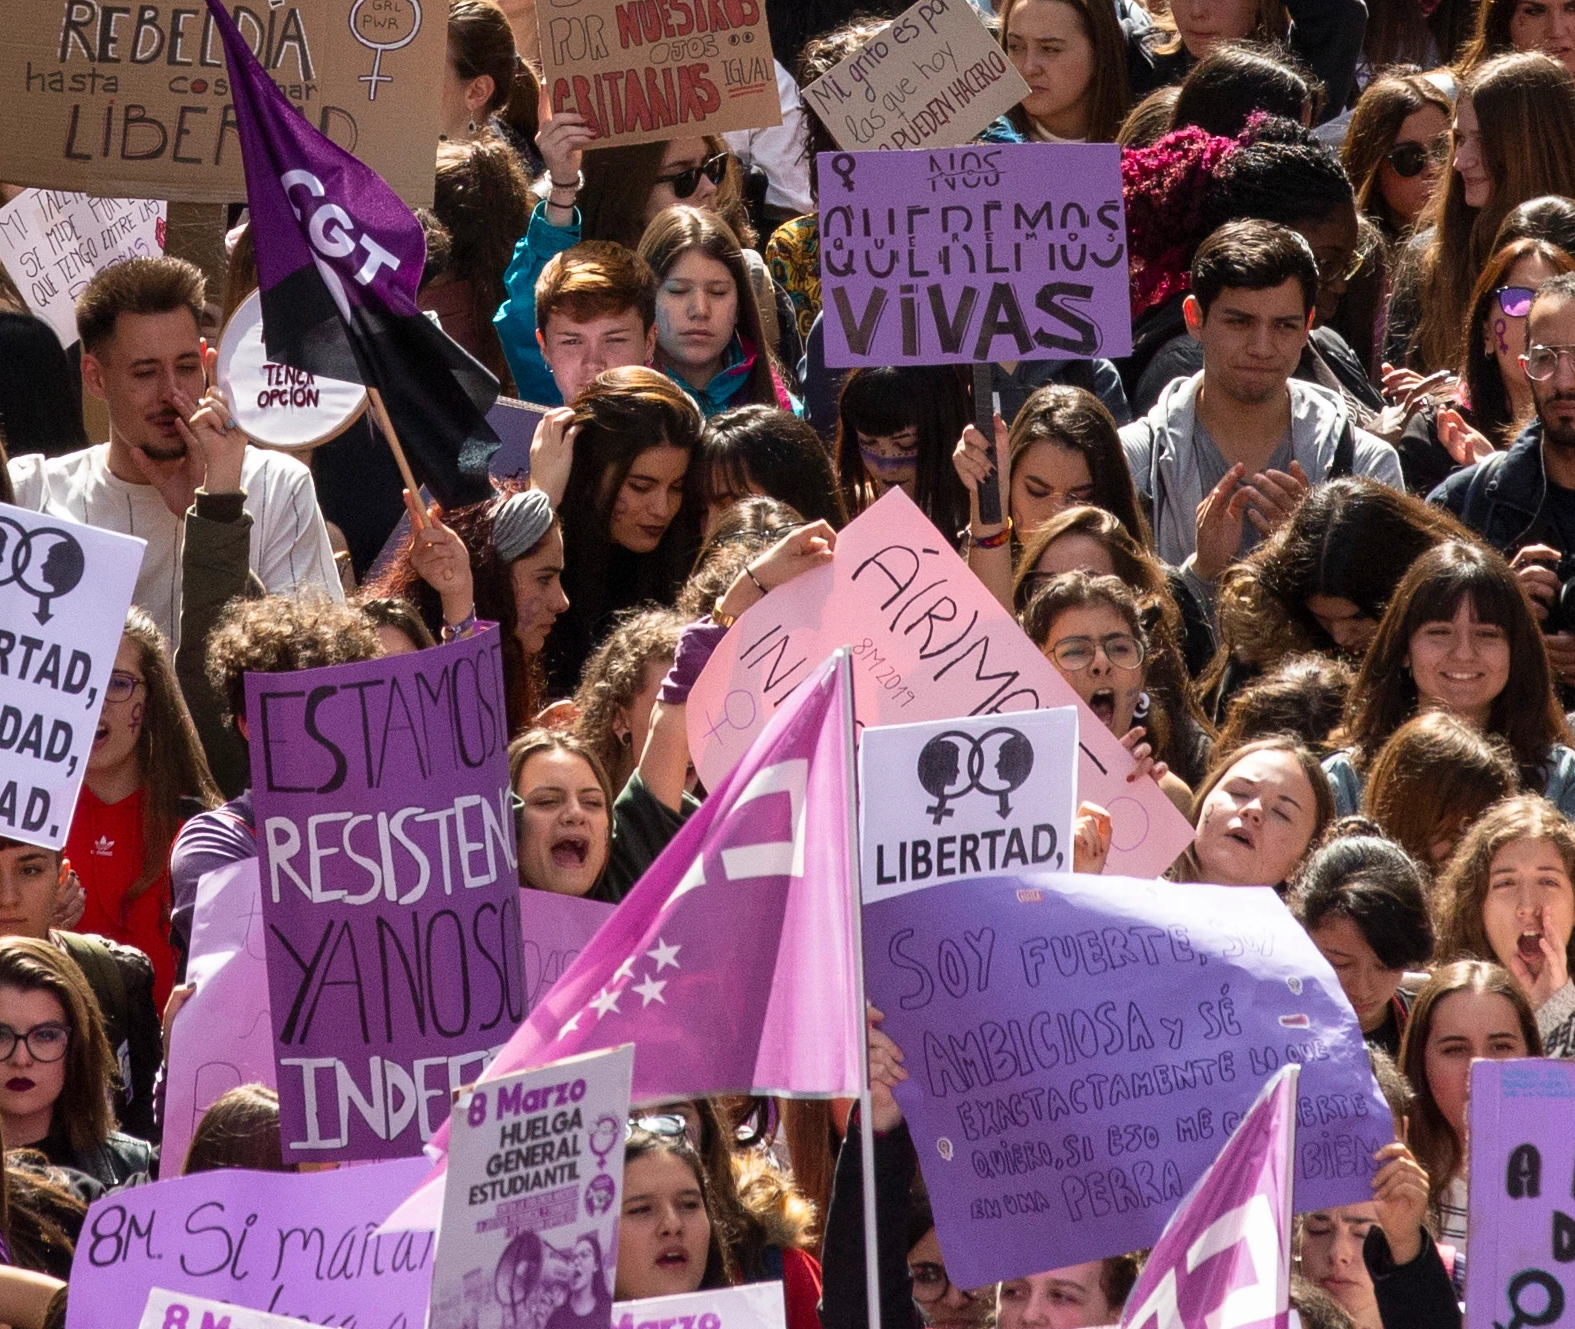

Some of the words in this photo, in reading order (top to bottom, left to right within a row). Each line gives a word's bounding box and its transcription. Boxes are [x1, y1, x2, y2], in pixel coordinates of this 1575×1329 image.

[362, 14, 400, 30] PWR
[371, 0, 402, 13] GRL
[549, 15, 609, 66] POR
[649, 34, 720, 64] OJOS
[844, 108, 886, 144] las
[882, 77, 918, 126] que
[912, 41, 959, 80] hoy
[280, 169, 401, 286] CGT
[260, 650, 501, 794] ESTAMOS
[875, 822, 1064, 885] LIBERTAD,
[270, 917, 369, 1045] YA
[378, 908, 472, 1044] NO
[466, 1092, 488, 1128] 8
[496, 1077, 588, 1122] Marzo
[499, 1107, 584, 1149] HUELGA
[484, 1134, 583, 1178] GENERAL
[467, 1160, 582, 1207] ESTUDIANTIL
